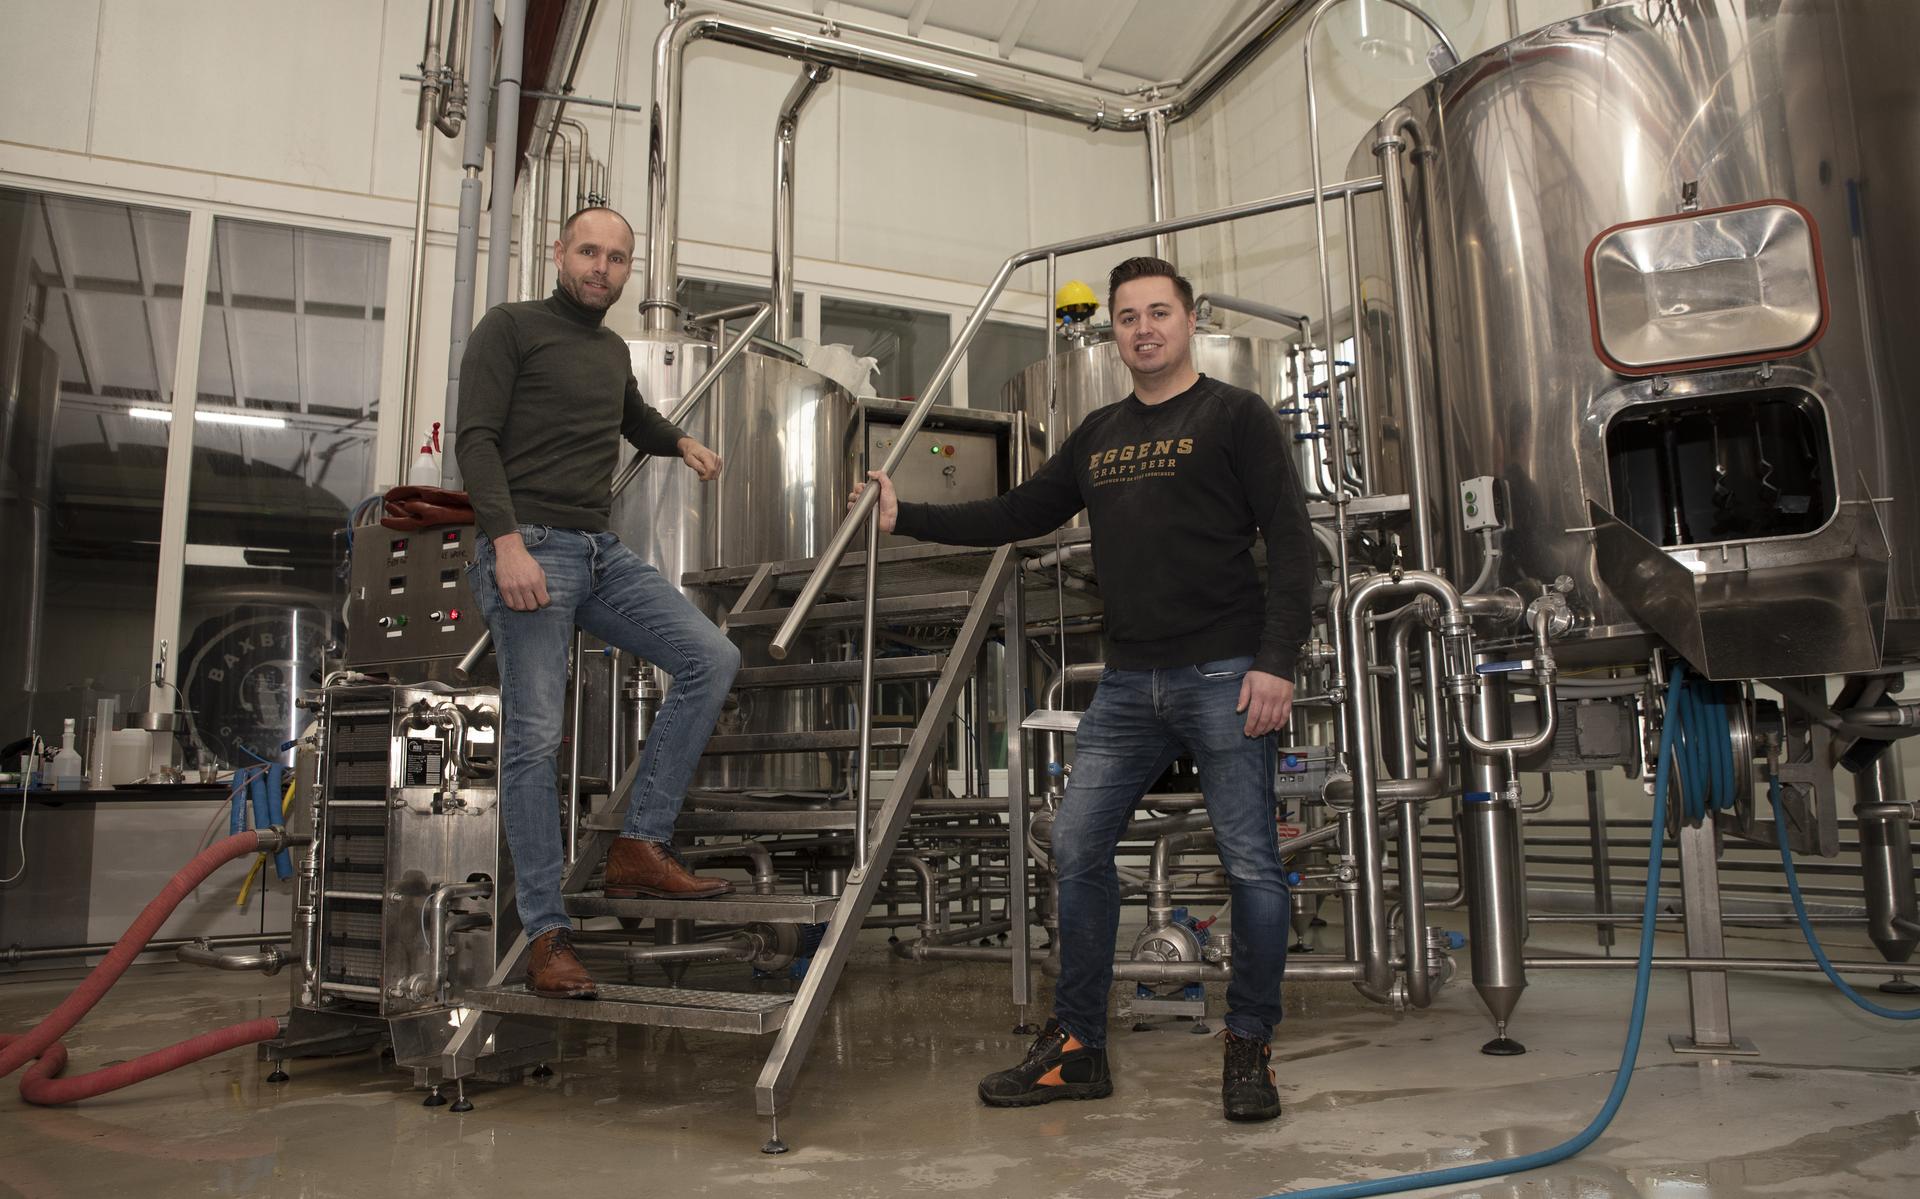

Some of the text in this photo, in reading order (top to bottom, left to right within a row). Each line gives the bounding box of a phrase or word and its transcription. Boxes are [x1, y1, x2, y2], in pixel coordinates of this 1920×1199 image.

[1089, 438, 1193, 470] EGGENS
[1094, 465, 1136, 479] CRAFT
[1141, 459, 1177, 471] BEER
